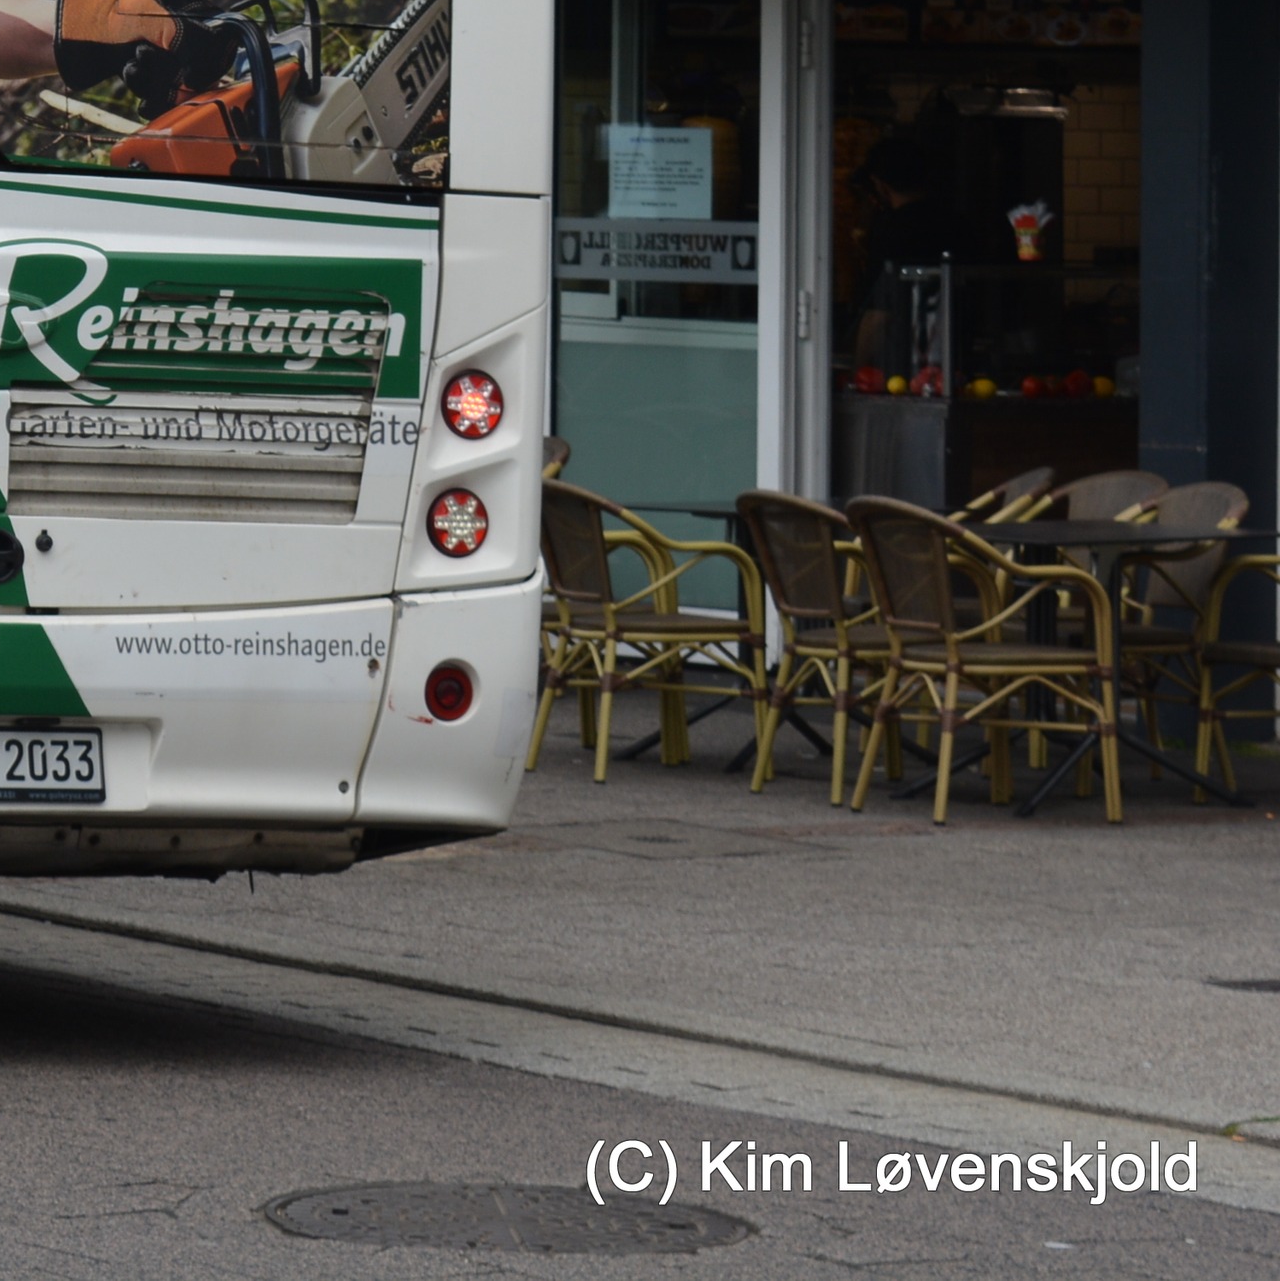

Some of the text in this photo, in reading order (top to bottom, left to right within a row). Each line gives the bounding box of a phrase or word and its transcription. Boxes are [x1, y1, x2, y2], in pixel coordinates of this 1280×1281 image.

[141, 407, 201, 441] und
[215, 408, 418, 451] Motorgeräte
[115, 632, 386, 662] www.otto-reinshagen.de
[5, 739, 94, 782] 2033
